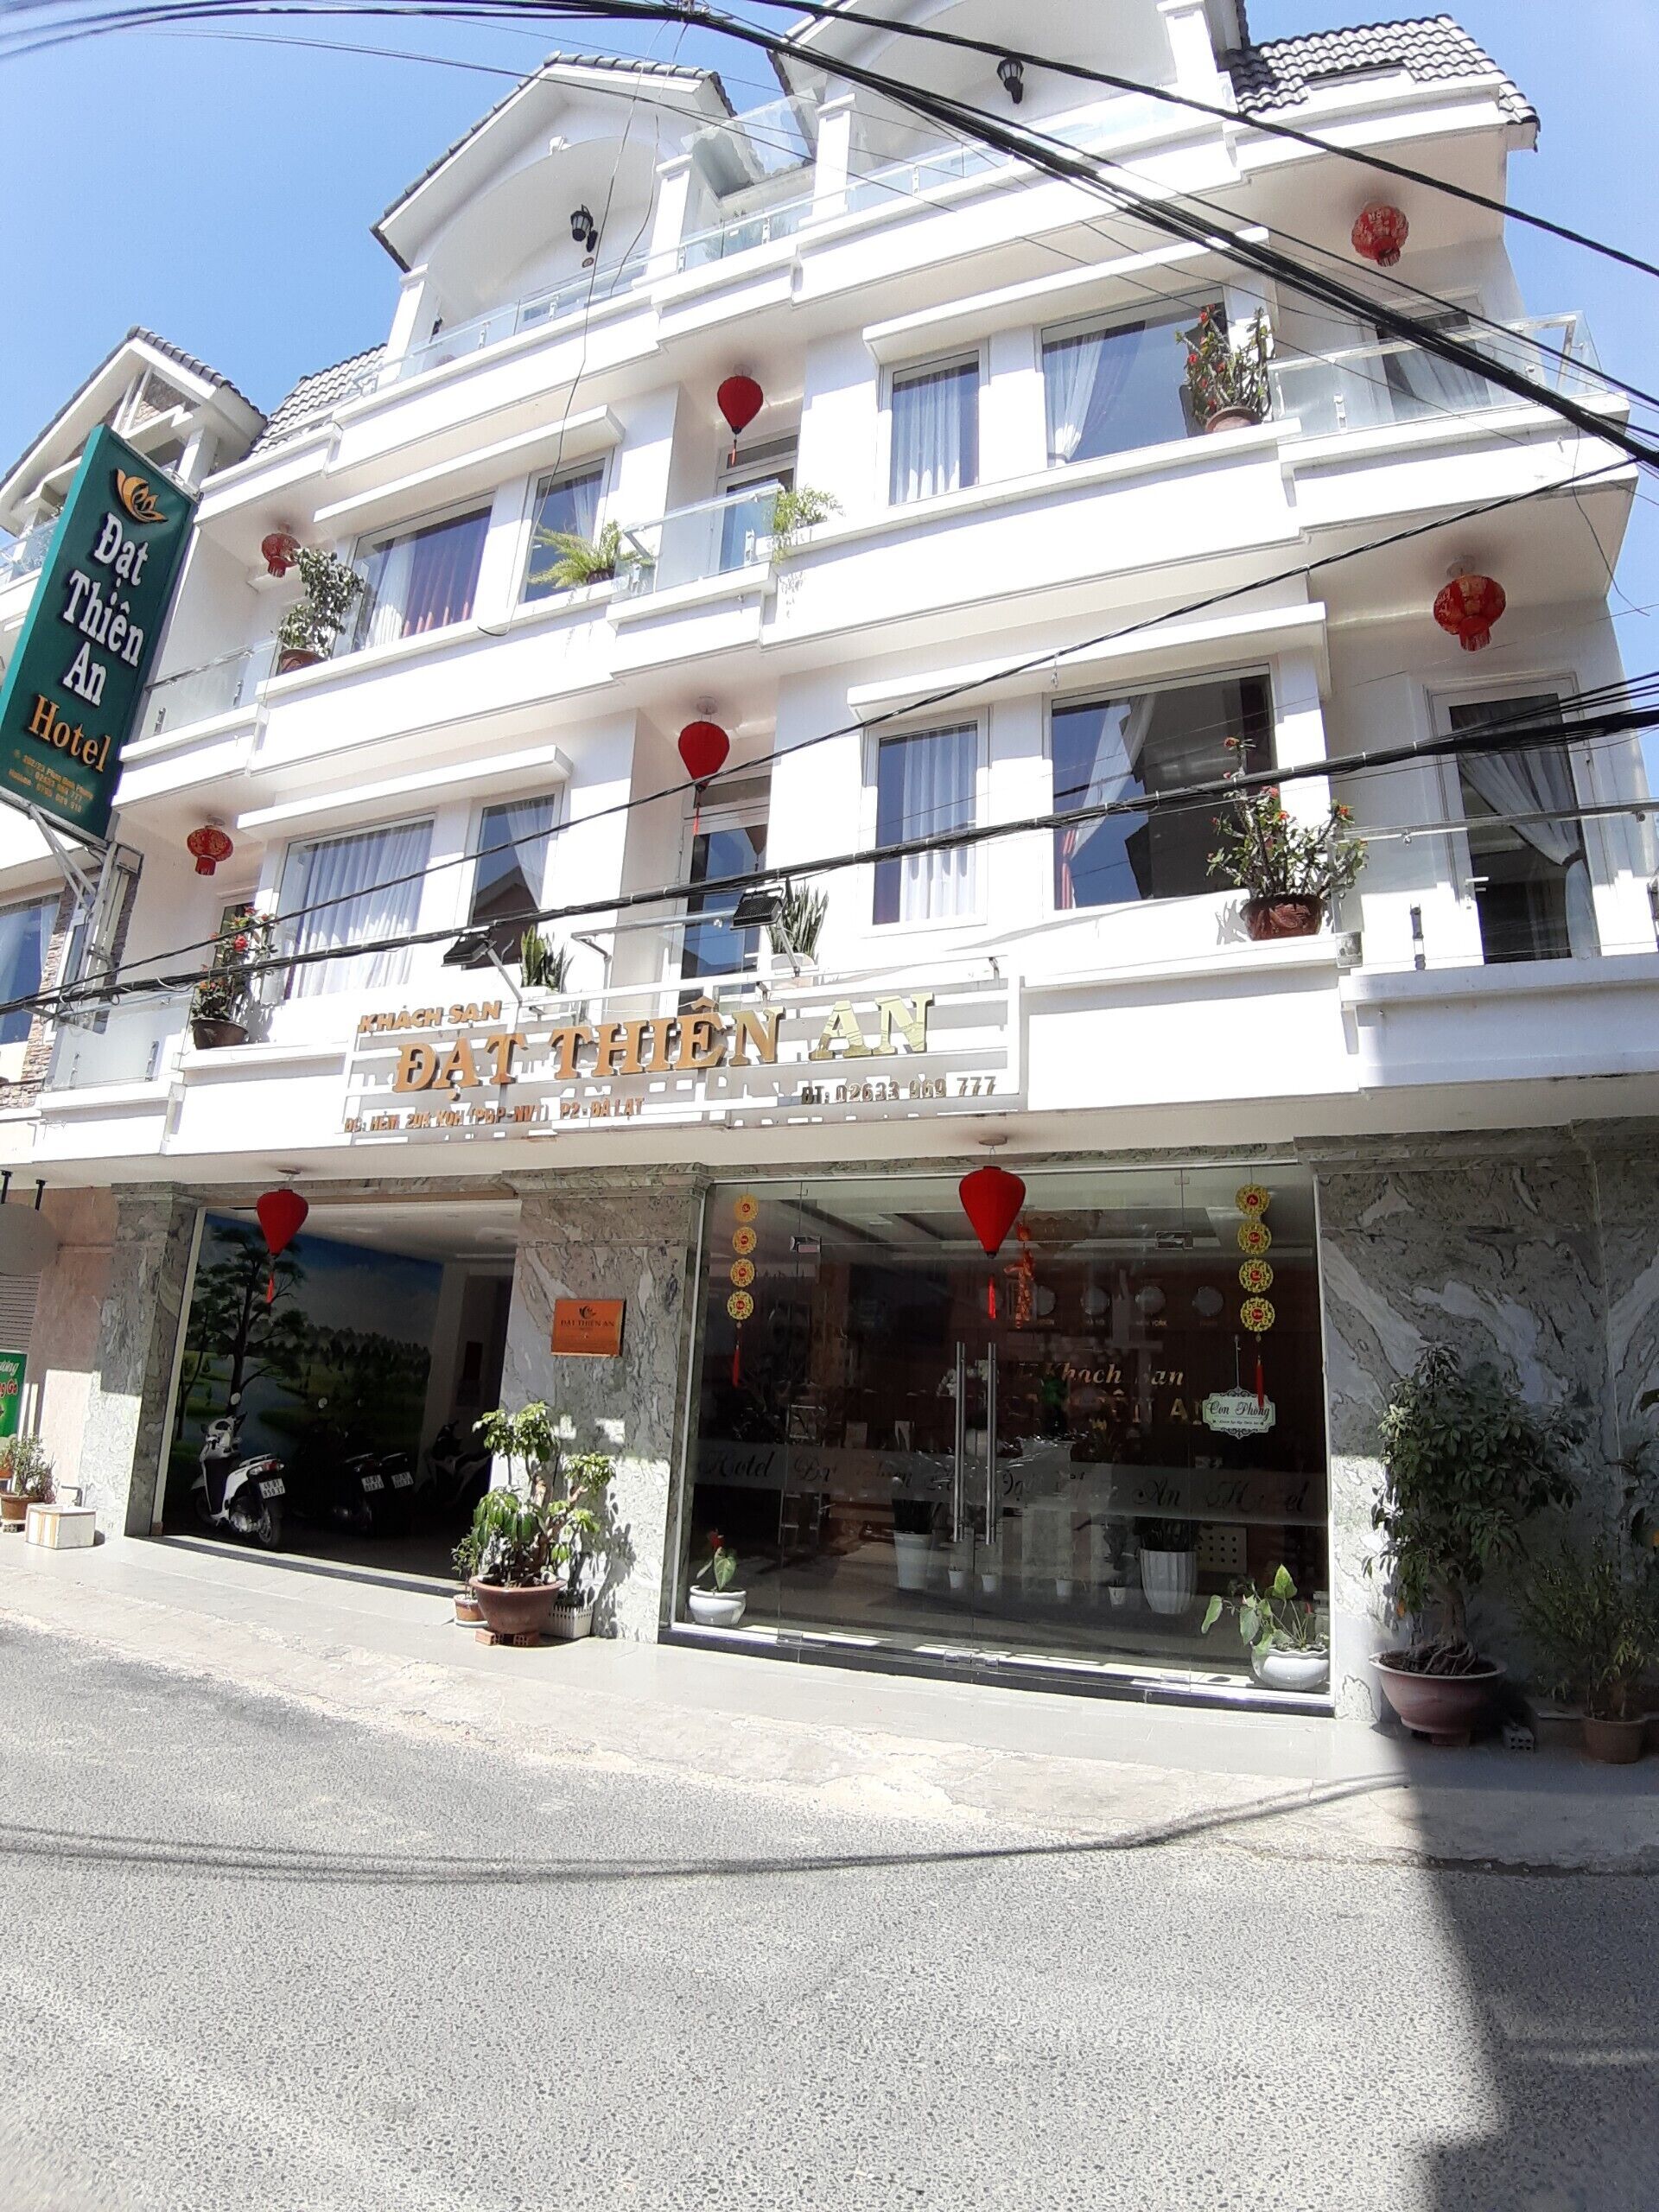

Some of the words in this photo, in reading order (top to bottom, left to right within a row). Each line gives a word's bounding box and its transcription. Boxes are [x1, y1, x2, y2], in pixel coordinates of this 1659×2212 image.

[93, 512, 149, 588] Đạt
[62, 569, 144, 668] Thiên
[62, 641, 107, 707] An
[28, 694, 111, 773] Hotel
[358, 1005, 444, 1033] KHÁCH
[448, 1000, 503, 1028] SẠN
[392, 1033, 529, 1102] ĐẠT
[549, 995, 785, 1078] THIÊN
[810, 991, 935, 1062] AN
[836, 1080, 899, 1103] 02633
[908, 1077, 946, 1100] 969
[957, 1075, 997, 1097] 777
